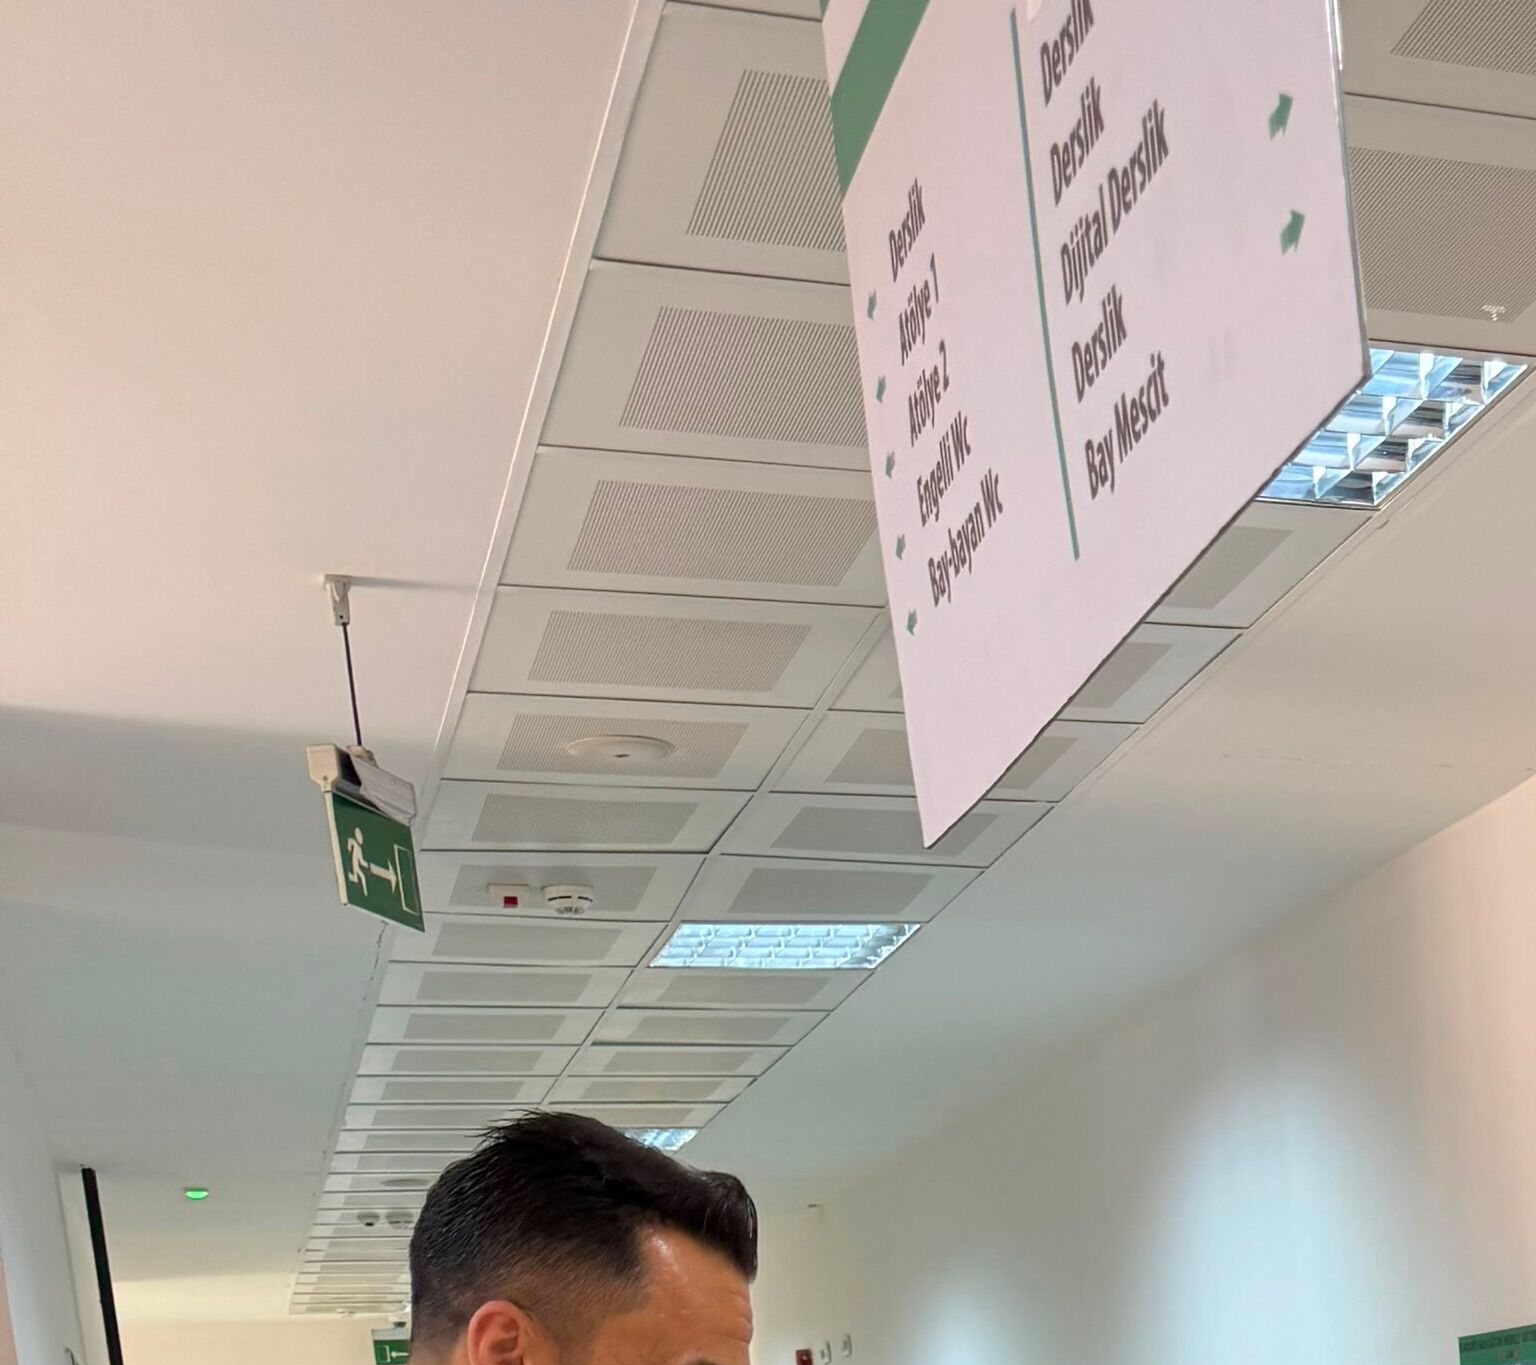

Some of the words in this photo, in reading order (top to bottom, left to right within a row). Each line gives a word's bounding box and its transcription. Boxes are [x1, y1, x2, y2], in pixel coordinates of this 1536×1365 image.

[1049, 75, 1105, 208] Derslik
[1060, 182, 1109, 307] Dijital
[1107, 98, 1169, 236] Derslik
[888, 177, 926, 283] Derslik
[899, 279, 932, 367] Atölye
[929, 252, 940, 304] 1
[1071, 283, 1128, 405] Derslik
[908, 365, 941, 448] Atölye
[939, 339, 950, 393] 2
[1085, 429, 1115, 501] Bay
[1113, 350, 1170, 464] Mescit
[917, 430, 955, 528] Engelli
[949, 410, 972, 472] Wc
[928, 501, 985, 608] Bay-bayan
[980, 467, 1004, 529] Wc
